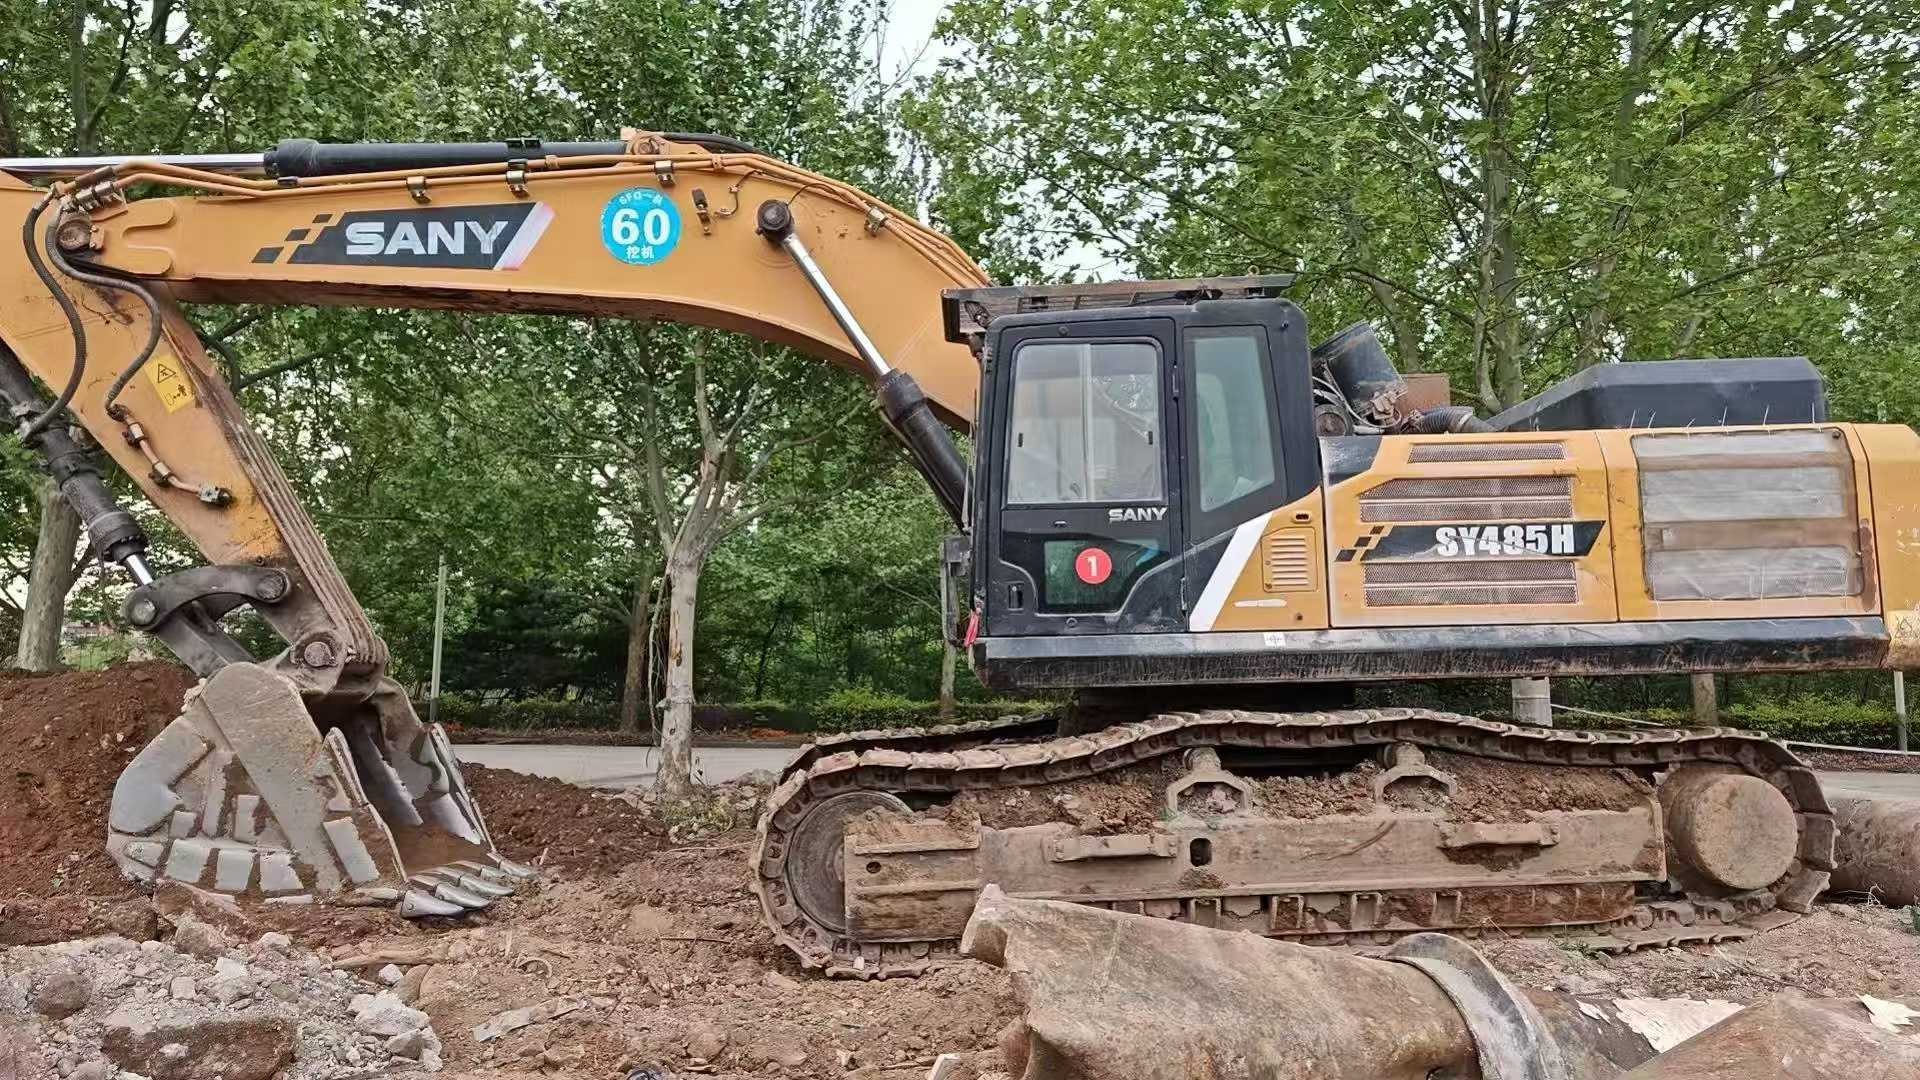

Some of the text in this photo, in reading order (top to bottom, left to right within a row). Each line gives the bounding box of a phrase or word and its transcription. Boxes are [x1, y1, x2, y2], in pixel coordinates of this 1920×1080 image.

[345, 221, 508, 255] SANY
[611, 208, 671, 245] 60
[626, 245, 655, 259] 挖机
[1108, 507, 1168, 521] SANY
[1435, 524, 1575, 556] SY485H
[1087, 555, 1098, 577] 1
